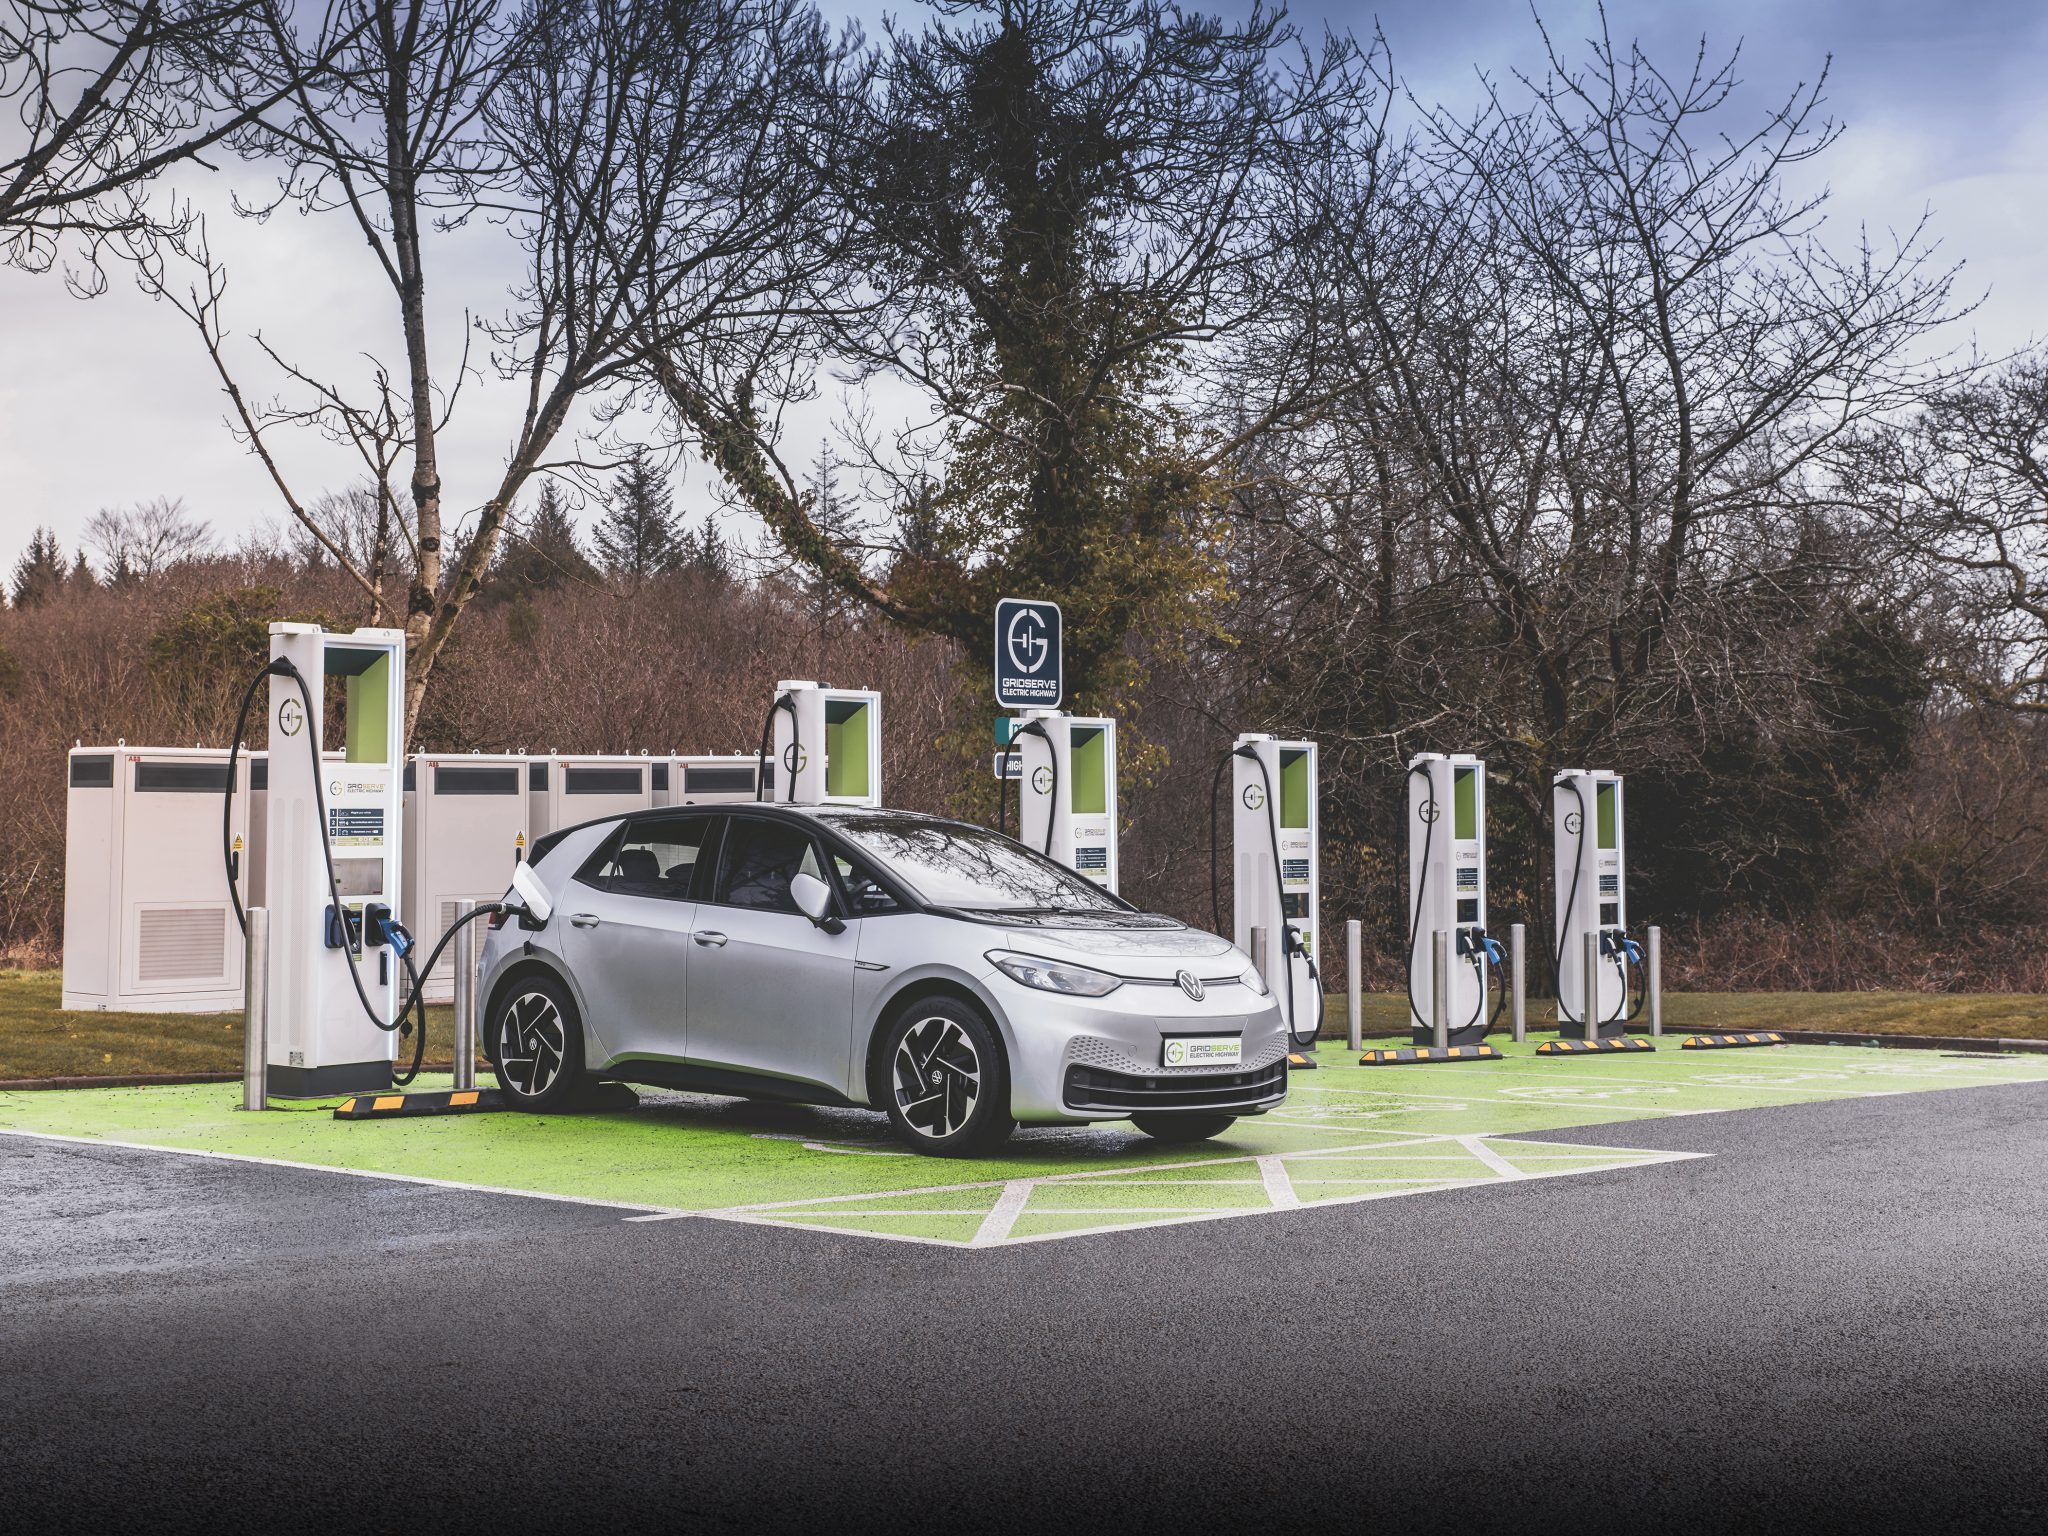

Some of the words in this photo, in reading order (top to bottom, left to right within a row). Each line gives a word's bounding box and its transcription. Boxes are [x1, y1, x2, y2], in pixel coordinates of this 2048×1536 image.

[1002, 677, 1057, 689] GRIDSERVE
[1002, 688, 1030, 697] ELECTRIC
[1029, 689, 1057, 698] HIGHWAY
[1190, 1044, 1240, 1052] GRIDSERVE
